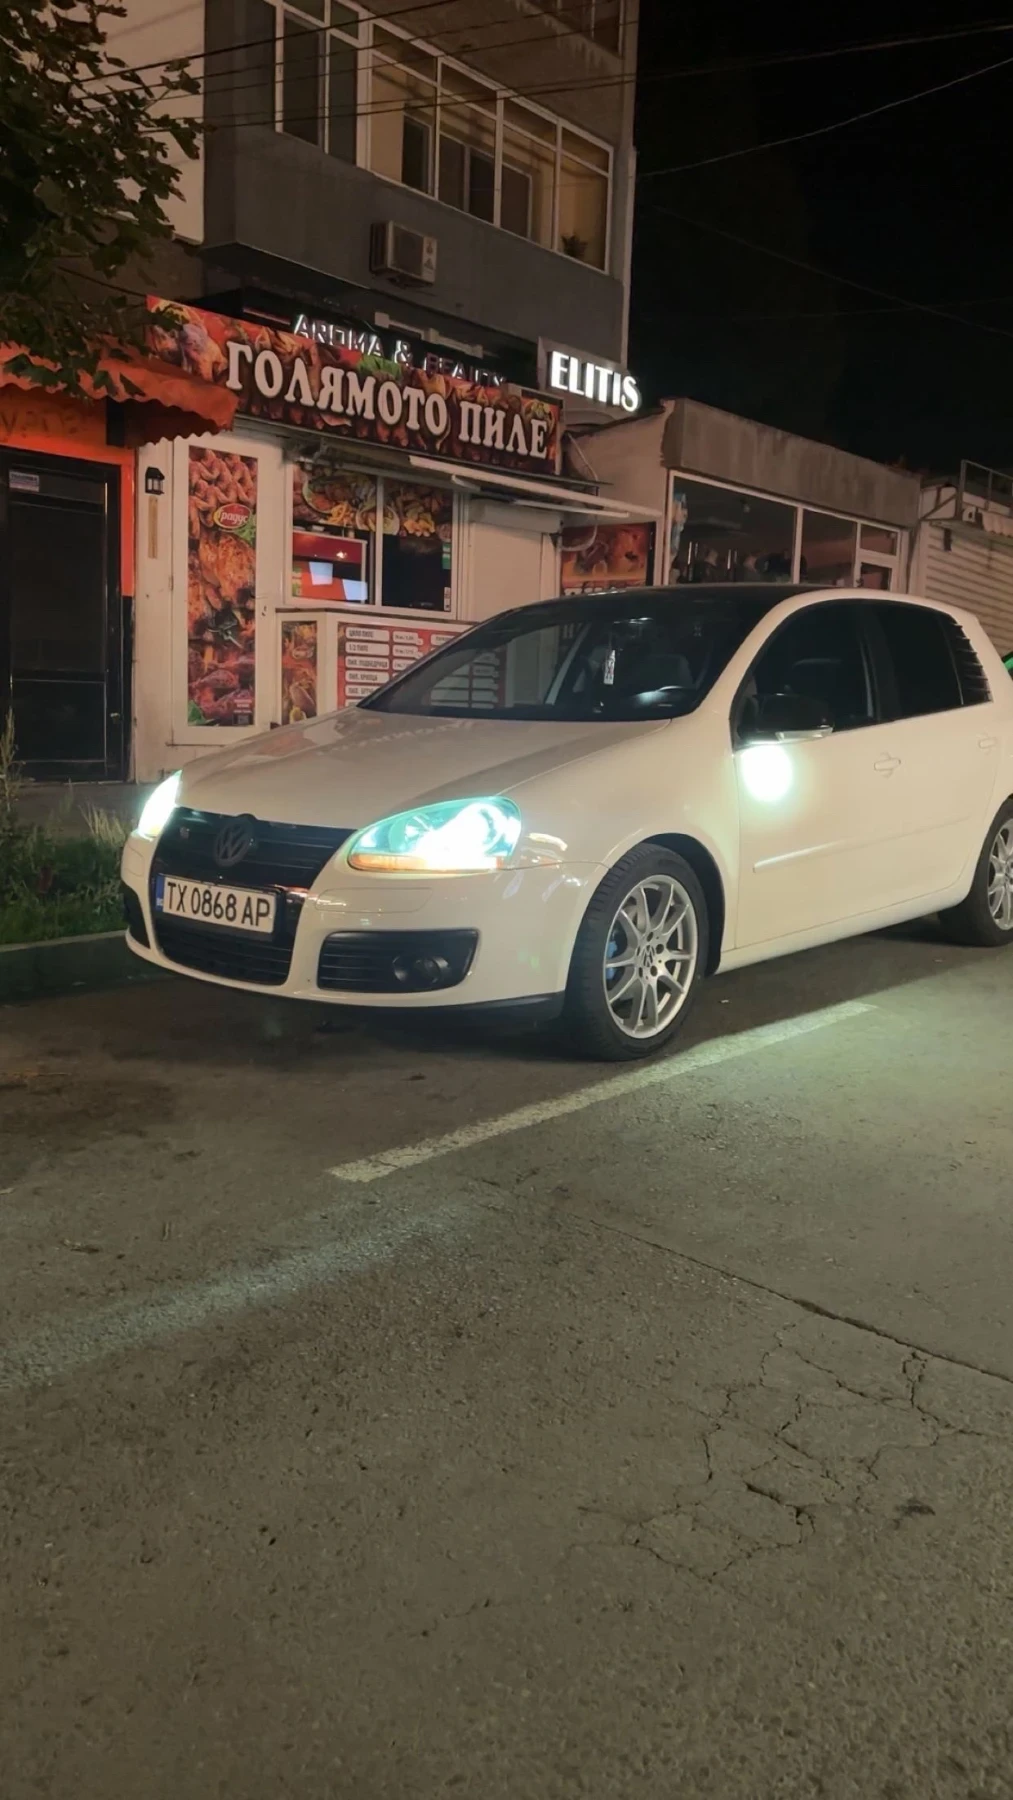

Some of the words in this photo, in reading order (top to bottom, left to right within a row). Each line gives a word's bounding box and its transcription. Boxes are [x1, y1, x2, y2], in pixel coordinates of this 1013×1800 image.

[225, 341, 449, 437] ГОЛЯМОТО
[457, 406, 550, 459] ПИЛЕ
[550, 350, 641, 413] ELITIS
[166, 881, 187, 913] TX
[190, 887, 238, 922] 0868
[240, 896, 271, 927] AP
